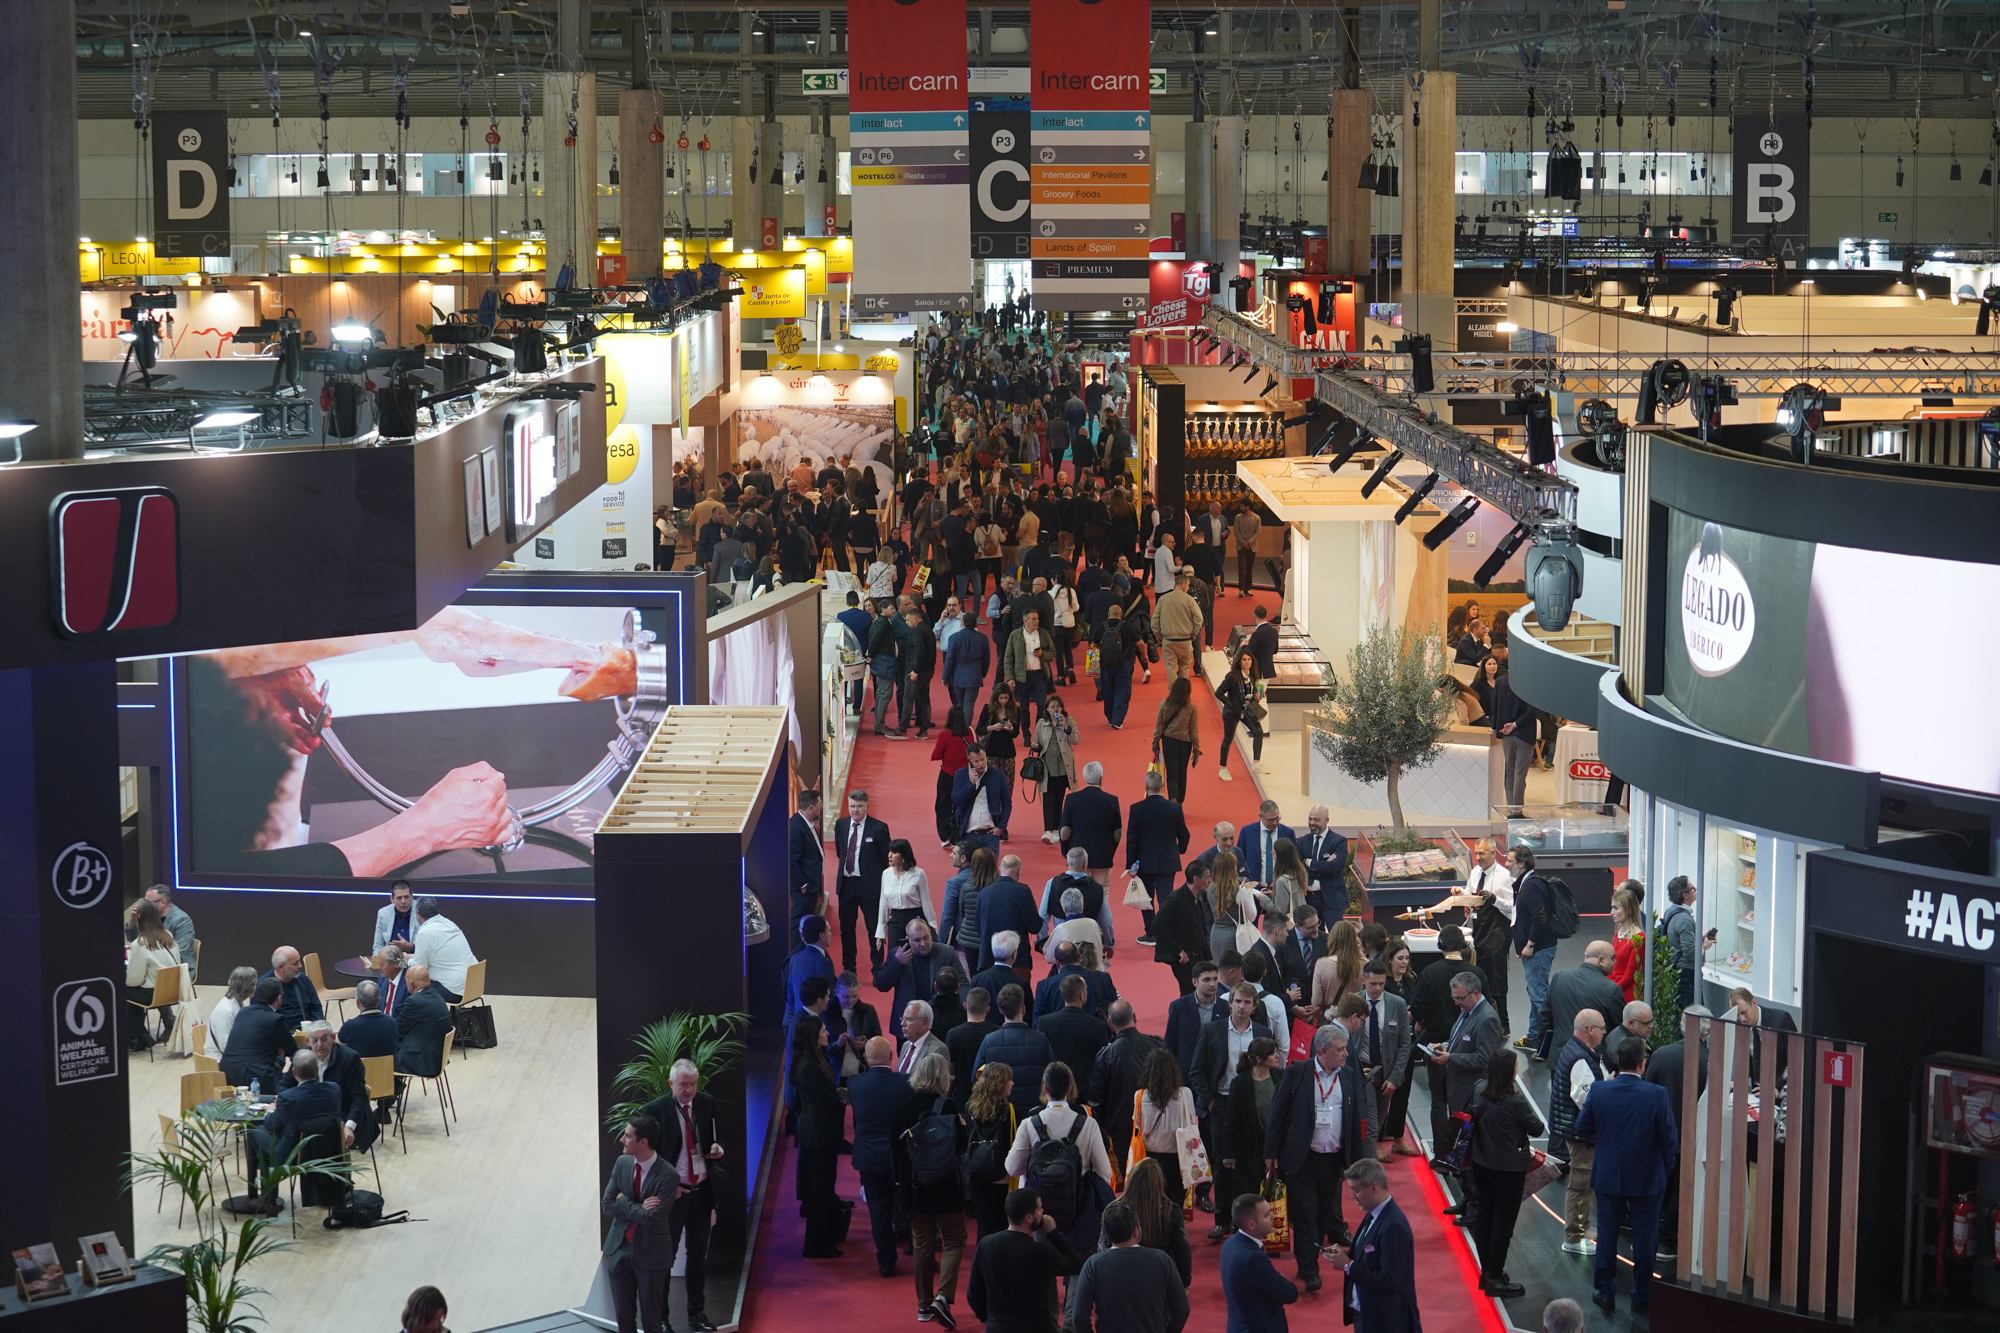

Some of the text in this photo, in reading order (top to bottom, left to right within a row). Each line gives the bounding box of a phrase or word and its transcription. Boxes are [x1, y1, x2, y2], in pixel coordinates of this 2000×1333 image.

[858, 72, 959, 91] Intercarn
[1041, 70, 1140, 90] Intercarn
[861, 118, 903, 128] Interlact
[1042, 117, 1084, 127] Interlact
[182, 135, 197, 146] P3
[996, 136, 1011, 147] P3
[1042, 151, 1053, 159] P2
[904, 172, 947, 180] Restaurama
[1042, 171, 1128, 179] International Pavilions
[166, 159, 218, 220] D
[977, 159, 1031, 223] C
[1042, 190, 1101, 200] Grocery Foods
[1746, 163, 1796, 223] B
[167, 234, 181, 253] E
[201, 233, 218, 253] C
[978, 236, 994, 255] D
[1015, 236, 1030, 255] B
[1045, 243, 1116, 254] Lands of Spain
[1780, 238, 1796, 257] A
[111, 250, 146, 265] LEÓN
[1067, 265, 1113, 274] PREMIUM
[1151, 299, 1187, 316] Cheese
[1147, 308, 1187, 328] Lovers
[1473, 330, 1494, 338] MIGUEL
[606, 525, 626, 534] POLLO
[1684, 573, 1746, 632] LEGADO
[1689, 629, 1724, 661] IBÉRICO
[60, 1038, 98, 1052] ANIMAL
[60, 1046, 107, 1062] WELFARE
[60, 1056, 110, 1071] CERTIFICATE
